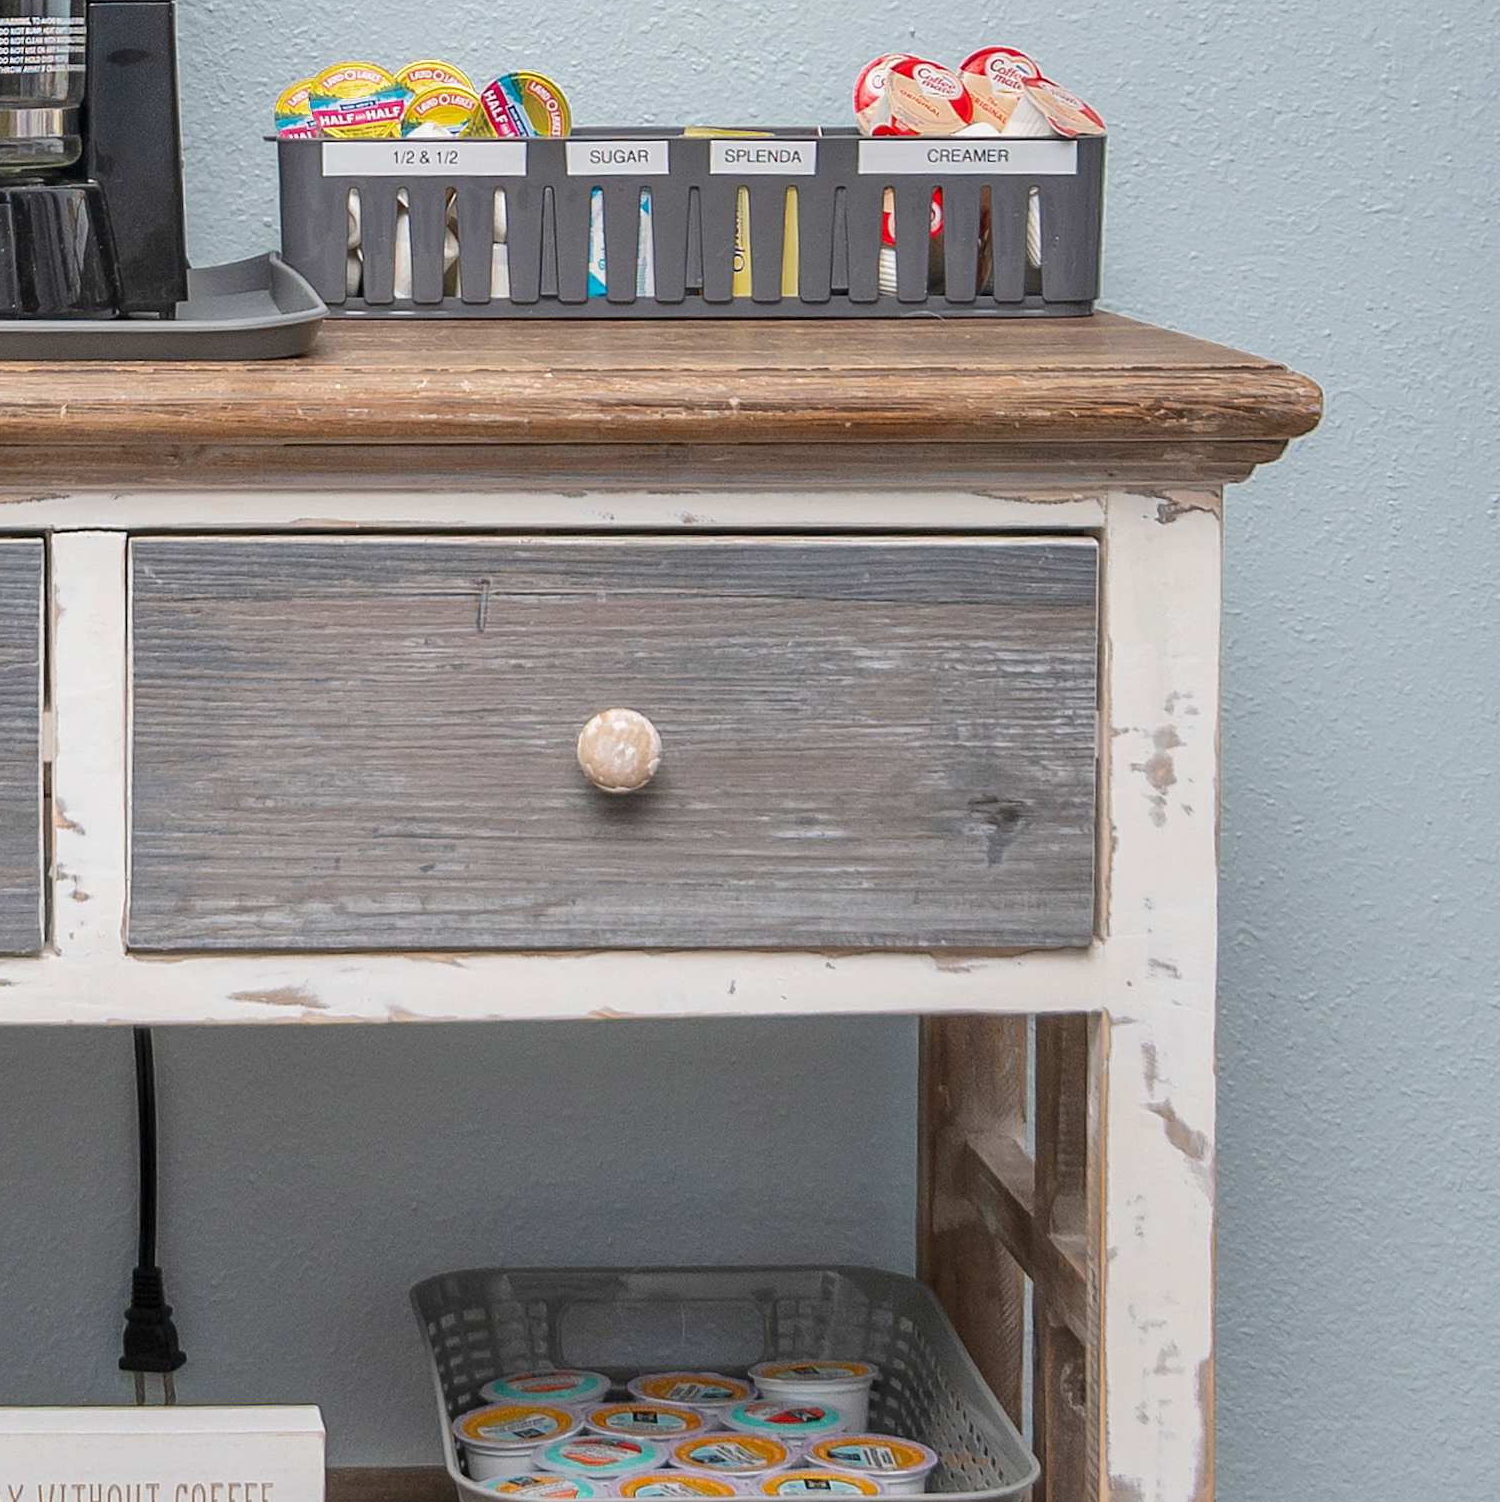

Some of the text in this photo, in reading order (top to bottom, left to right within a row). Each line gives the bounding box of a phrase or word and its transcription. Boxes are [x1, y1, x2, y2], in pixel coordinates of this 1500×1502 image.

[990, 58, 1024, 79] Coffe
[917, 67, 957, 90] Coffee
[921, 79, 956, 95] mate
[483, 89, 509, 124] HALF
[320, 113, 355, 127] HALF
[365, 105, 402, 121] HALF
[393, 150, 459, 165] 1/2 & 1/2
[589, 149, 650, 164] SUGAR
[724, 149, 802, 164] SPLENDA
[927, 149, 1010, 164] CREAMER
